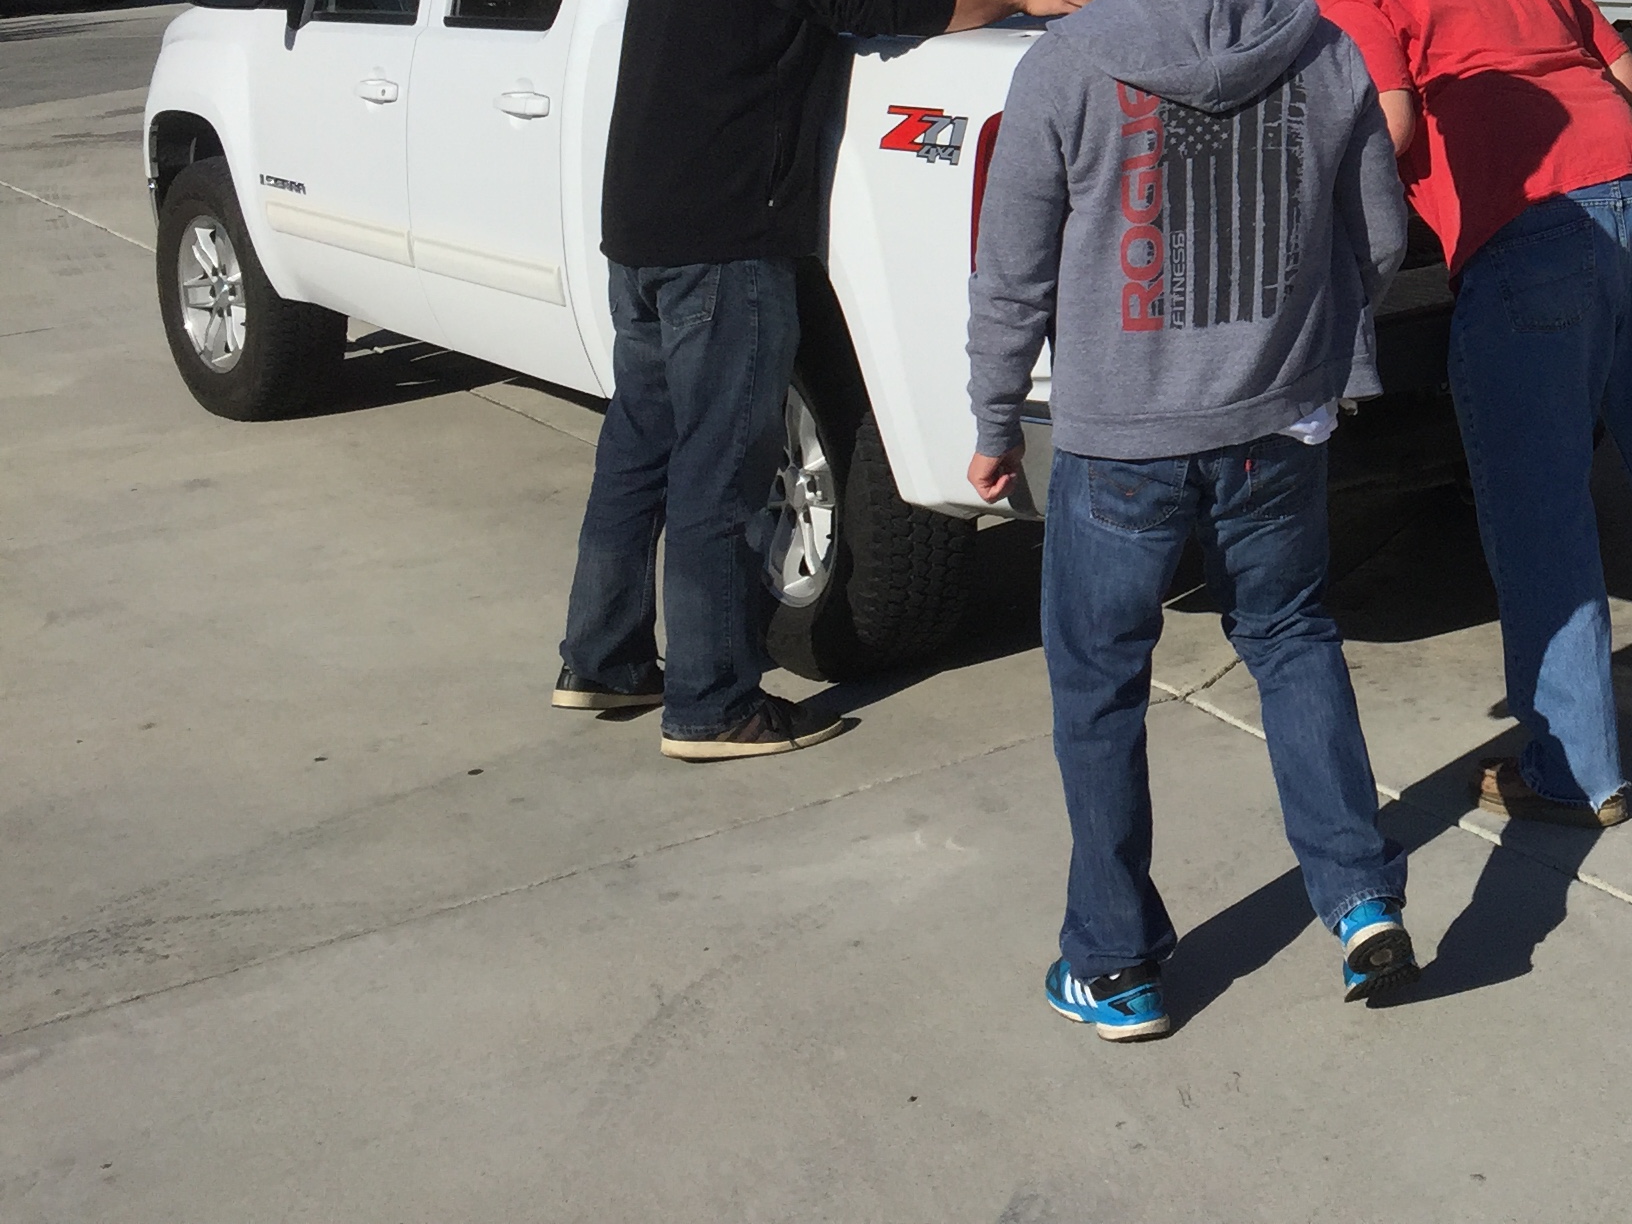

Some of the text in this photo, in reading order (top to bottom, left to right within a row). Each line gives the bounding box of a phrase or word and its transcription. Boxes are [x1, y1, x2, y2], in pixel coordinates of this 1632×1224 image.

[879, 104, 968, 152] Z71
[1117, 79, 1165, 333] ROGUE
[1172, 232, 1185, 330] FITNESS
